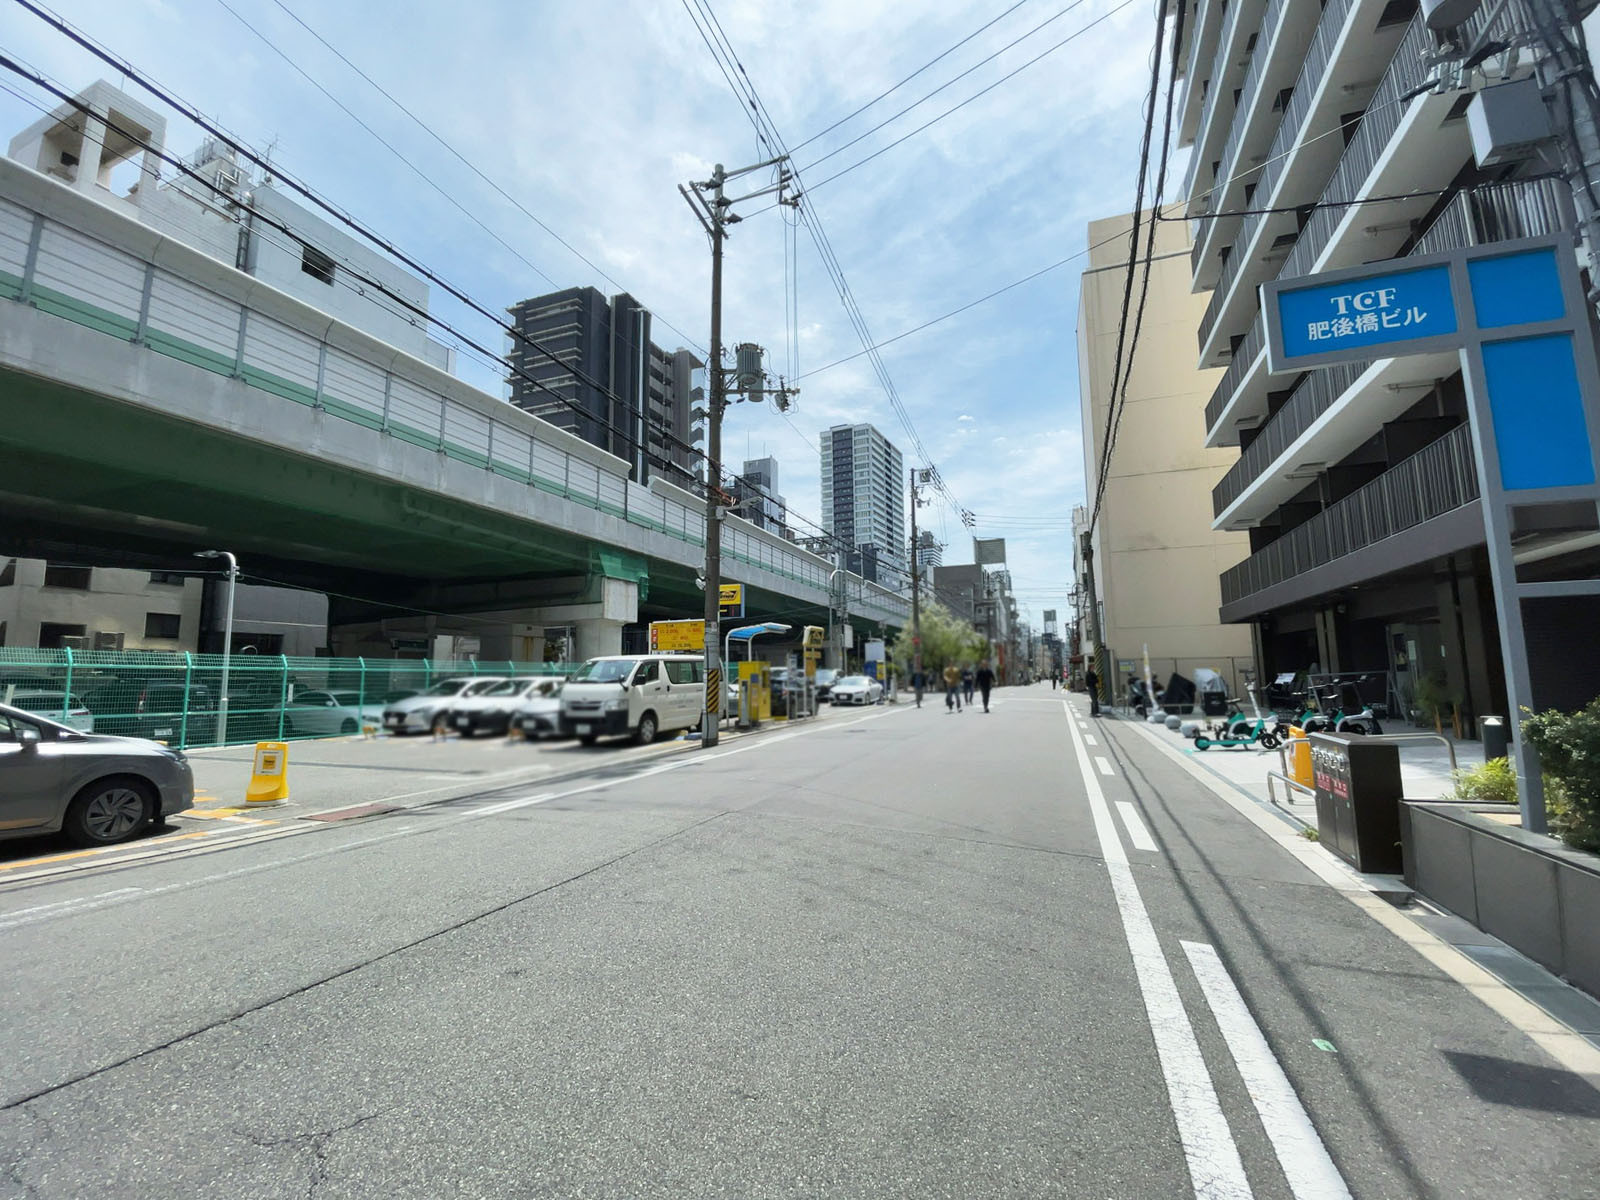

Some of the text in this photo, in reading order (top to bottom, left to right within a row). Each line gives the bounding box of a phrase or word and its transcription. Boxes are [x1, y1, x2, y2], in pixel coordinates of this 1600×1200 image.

[1330, 287, 1397, 315] TCF
[1307, 306, 1428, 341] 肥後橋ビル
